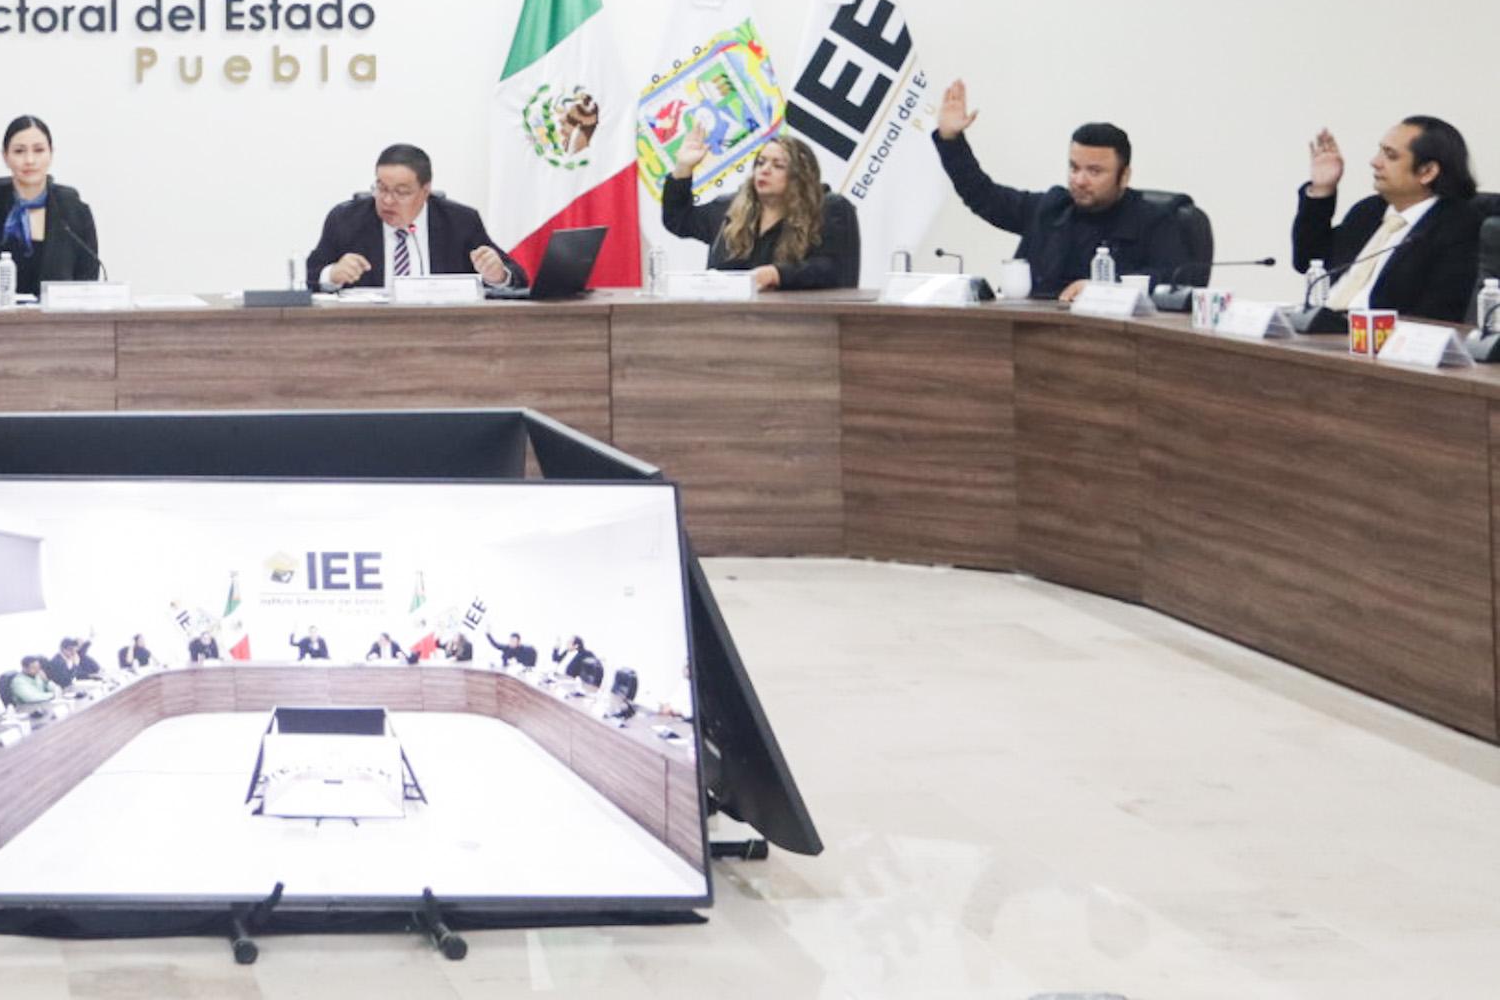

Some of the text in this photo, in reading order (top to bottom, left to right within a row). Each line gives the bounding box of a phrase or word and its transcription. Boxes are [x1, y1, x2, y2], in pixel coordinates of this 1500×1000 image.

[136, 44, 378, 85] Puebla
[851, 121, 902, 200] Electoral
[899, 89, 921, 122] del
[306, 551, 384, 590] IEE
